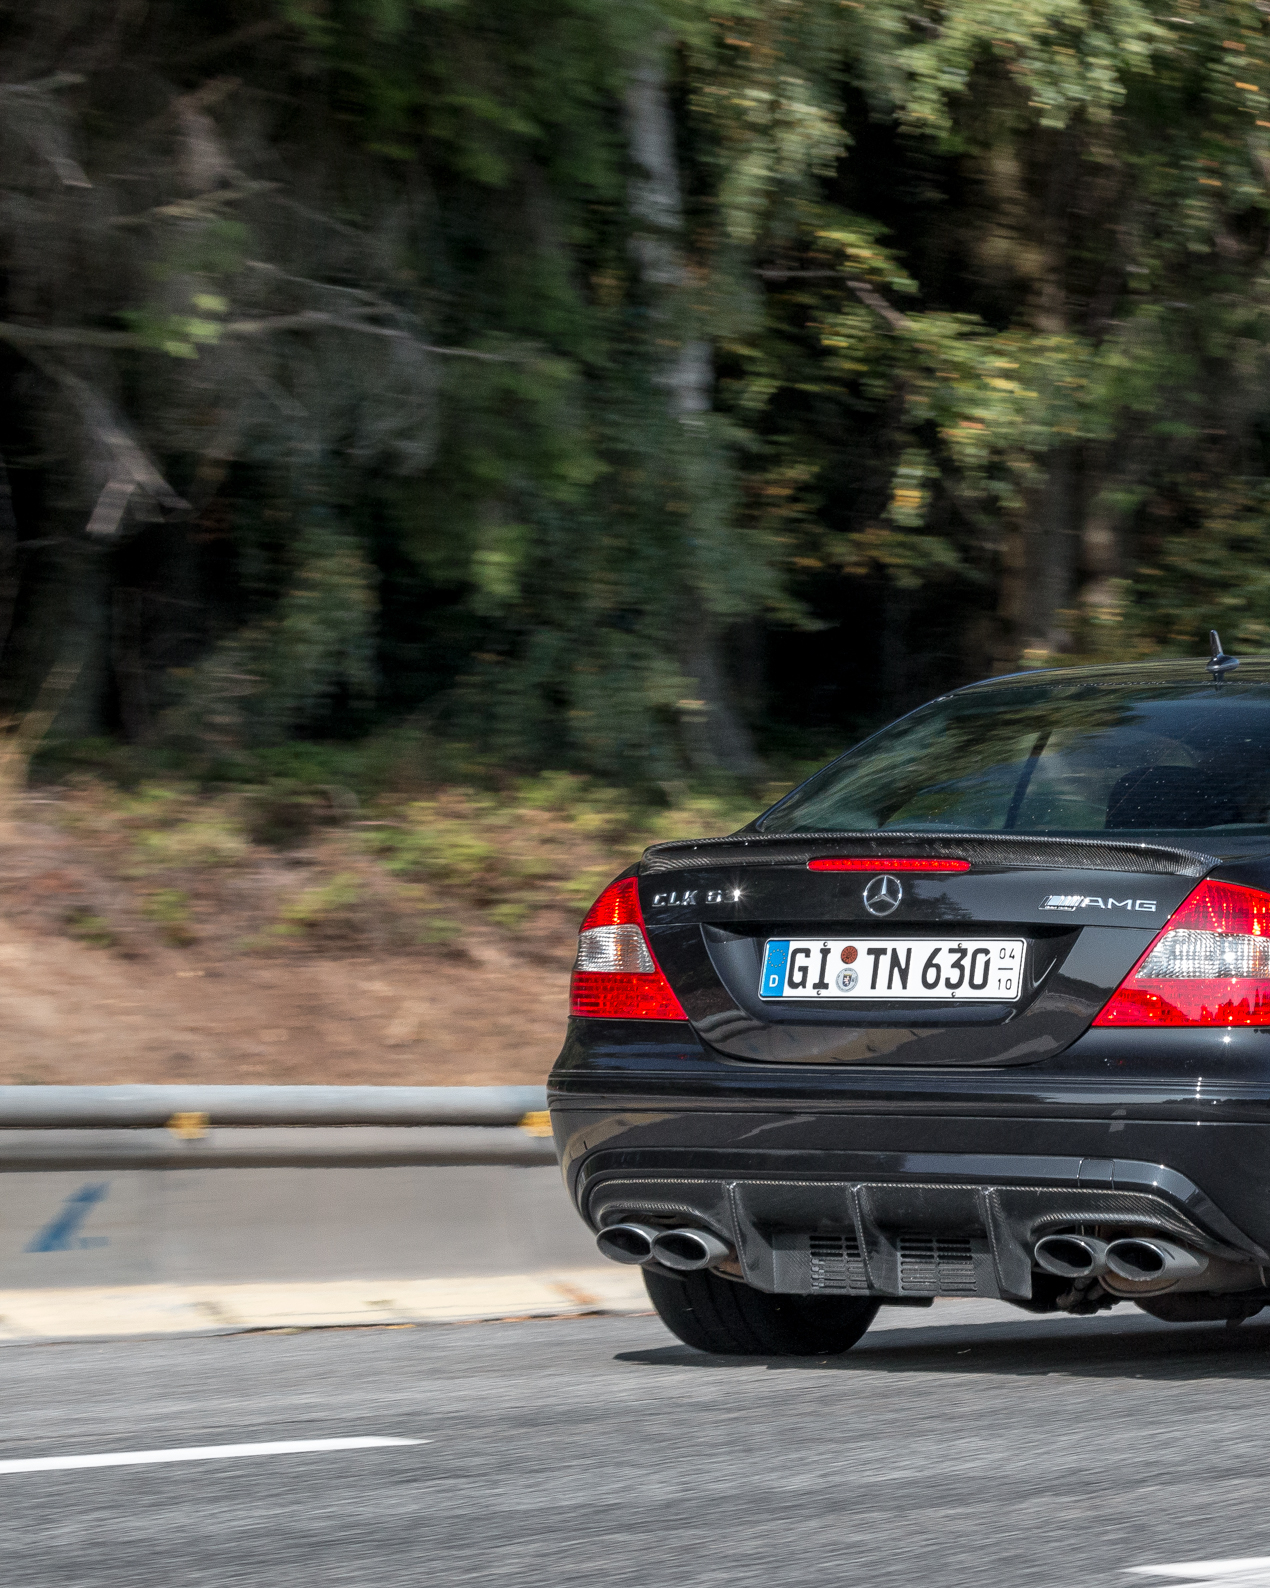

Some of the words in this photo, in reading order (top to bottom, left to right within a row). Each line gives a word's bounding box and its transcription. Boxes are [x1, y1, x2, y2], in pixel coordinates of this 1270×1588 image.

[651, 890, 698, 907] CLK
[1081, 897, 1157, 912] AMG
[999, 947, 1016, 960] 04
[787, 947, 832, 990] GI
[866, 947, 913, 990] TN
[921, 947, 991, 990] 630
[769, 974, 779, 988] D
[997, 978, 1013, 991] 10
